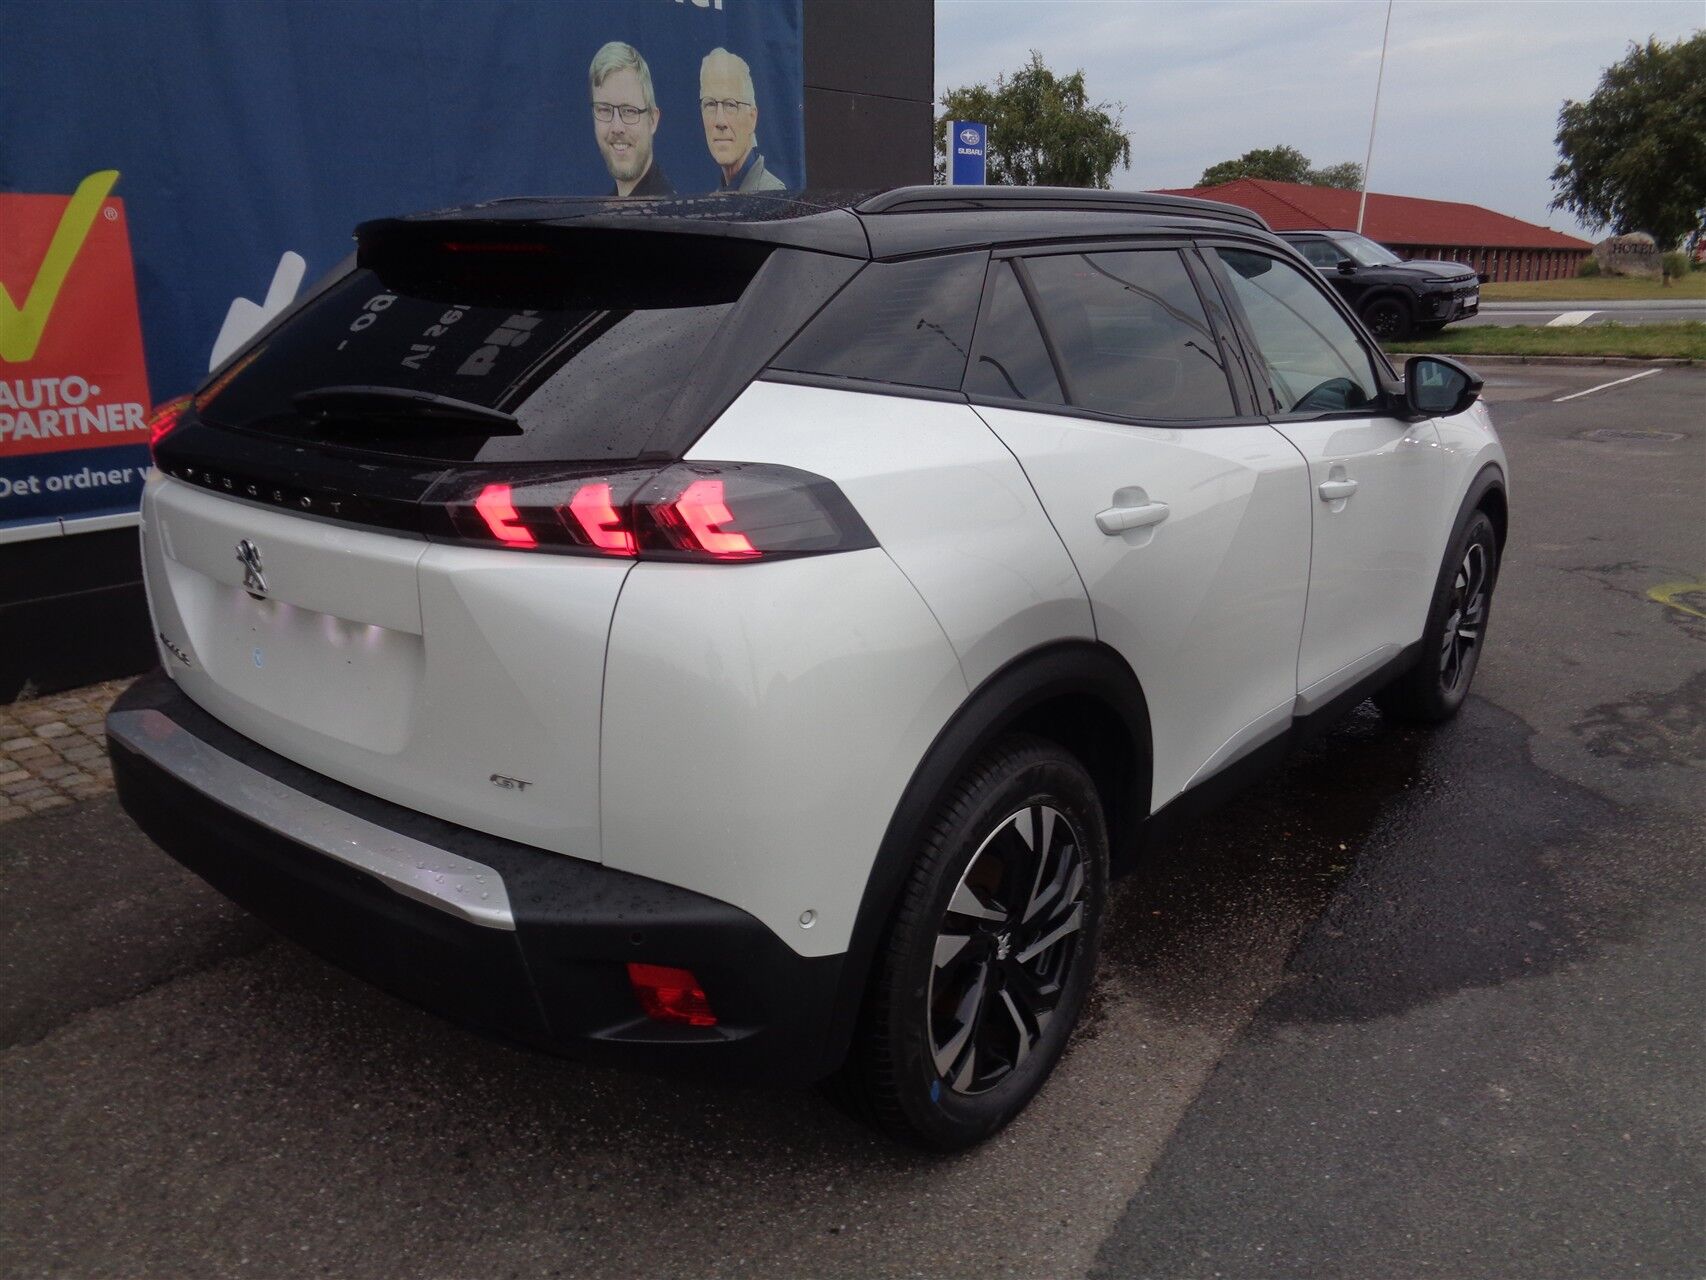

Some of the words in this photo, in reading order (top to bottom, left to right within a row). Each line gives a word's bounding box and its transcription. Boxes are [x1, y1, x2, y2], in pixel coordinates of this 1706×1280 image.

[958, 147, 983, 155] SUBARU
[1613, 243, 1655, 255] HOTEL
[0, 402, 149, 443] PARTNER
[0, 474, 41, 498] Det
[45, 467, 134, 492] ordner
[489, 773, 534, 792] GT
